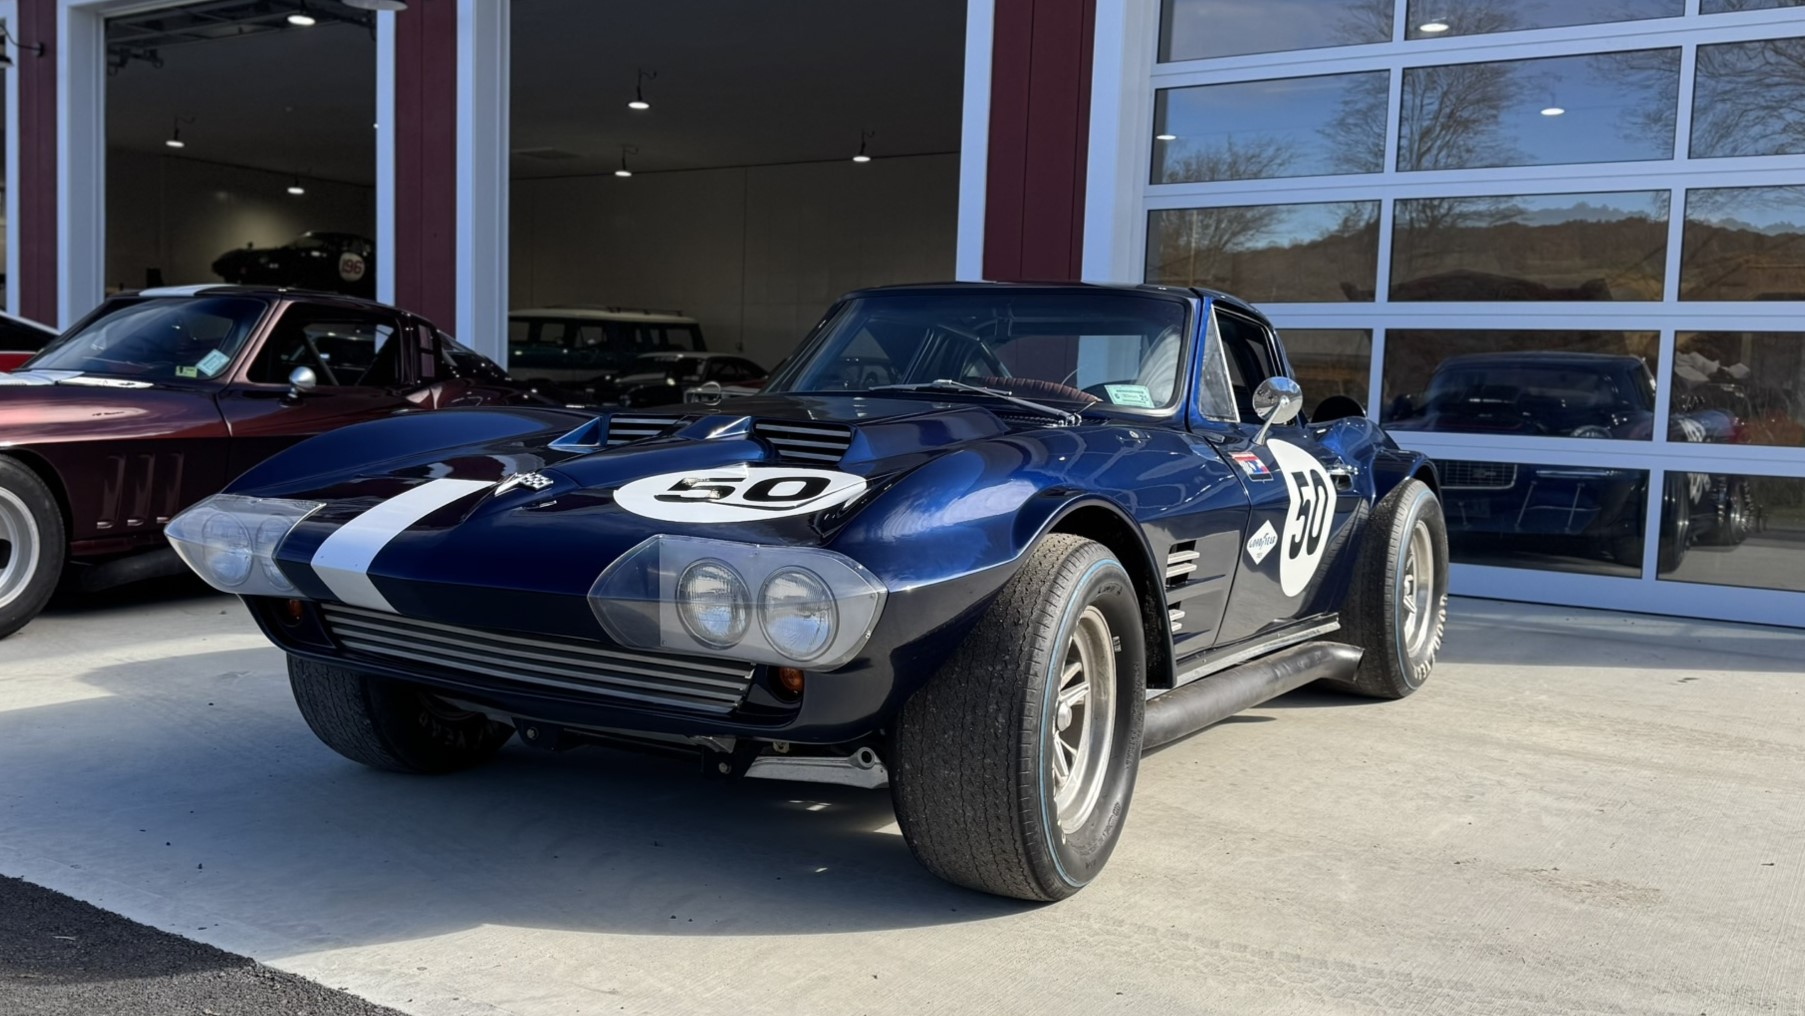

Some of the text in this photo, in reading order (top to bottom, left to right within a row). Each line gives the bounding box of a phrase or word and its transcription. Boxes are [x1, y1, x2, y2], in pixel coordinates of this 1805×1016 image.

[342, 258, 363, 275] 196
[654, 476, 831, 502] 50
[1289, 469, 1329, 560] 50
